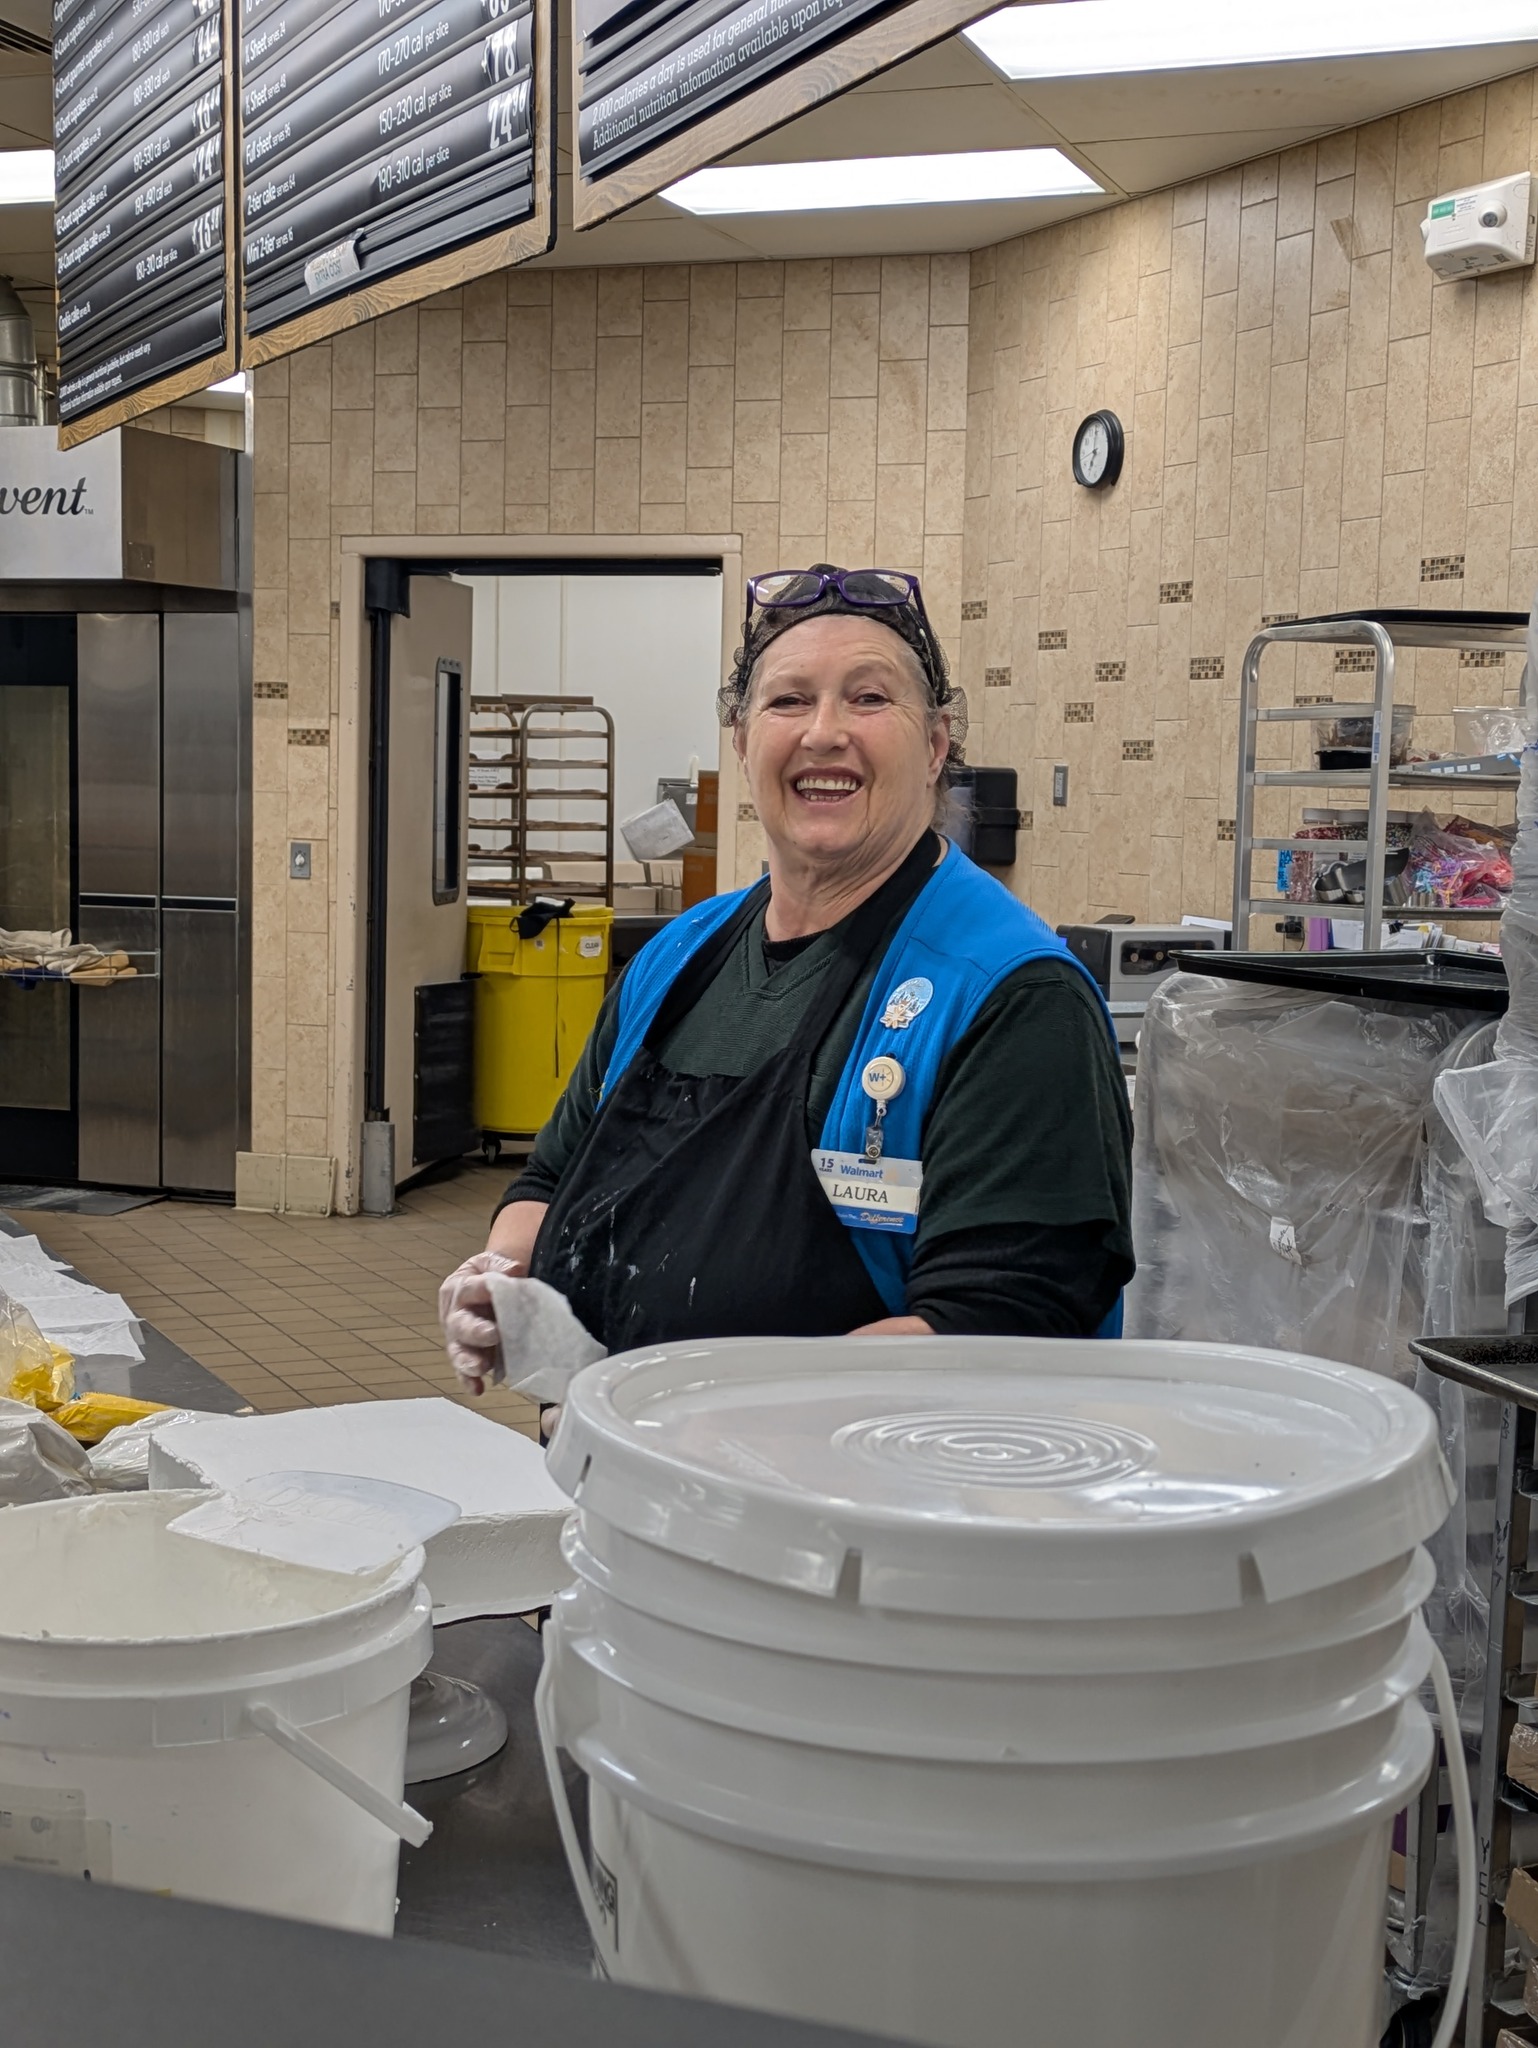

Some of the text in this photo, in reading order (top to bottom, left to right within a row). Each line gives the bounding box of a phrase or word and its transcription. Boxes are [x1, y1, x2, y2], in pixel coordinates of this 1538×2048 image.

[161, 21, 169, 38] each
[411, 25, 424, 55] cal
[425, 31, 435, 52] per
[436, 22, 449, 40] slice
[250, 32, 267, 61] Sheet
[154, 68, 162, 90] cal
[162, 68, 170, 83] each
[592, 97, 613, 126] 2,000
[614, 80, 648, 112] calories
[649, 75, 657, 90] a
[658, 64, 676, 83] day
[676, 55, 685, 74] is
[688, 34, 711, 66] used
[712, 28, 727, 52] for
[727, 4, 768, 45] general
[593, 4, 820, 151] Additional nutrition information available upon
[250, 84, 267, 111] Sheet
[414, 87, 426, 115] cal
[428, 93, 439, 112] per
[439, 83, 452, 102] slice
[162, 137, 171, 152] each
[246, 140, 256, 165] Full
[256, 131, 272, 158] sheet
[272, 130, 284, 147] serves
[412, 147, 424, 176] cal
[426, 154, 436, 174] per
[436, 146, 450, 164] slice
[164, 180, 173, 196] each
[247, 191, 262, 216] 2-tier
[262, 182, 276, 205] cake
[276, 183, 289, 197] serves
[246, 240, 259, 265] Mini
[260, 233, 276, 258] 2-tier
[276, 235, 288, 248] serves
[820, 1158, 834, 1169] 15
[840, 1165, 884, 1179] Walmart
[832, 1184, 888, 1203] LAURA
